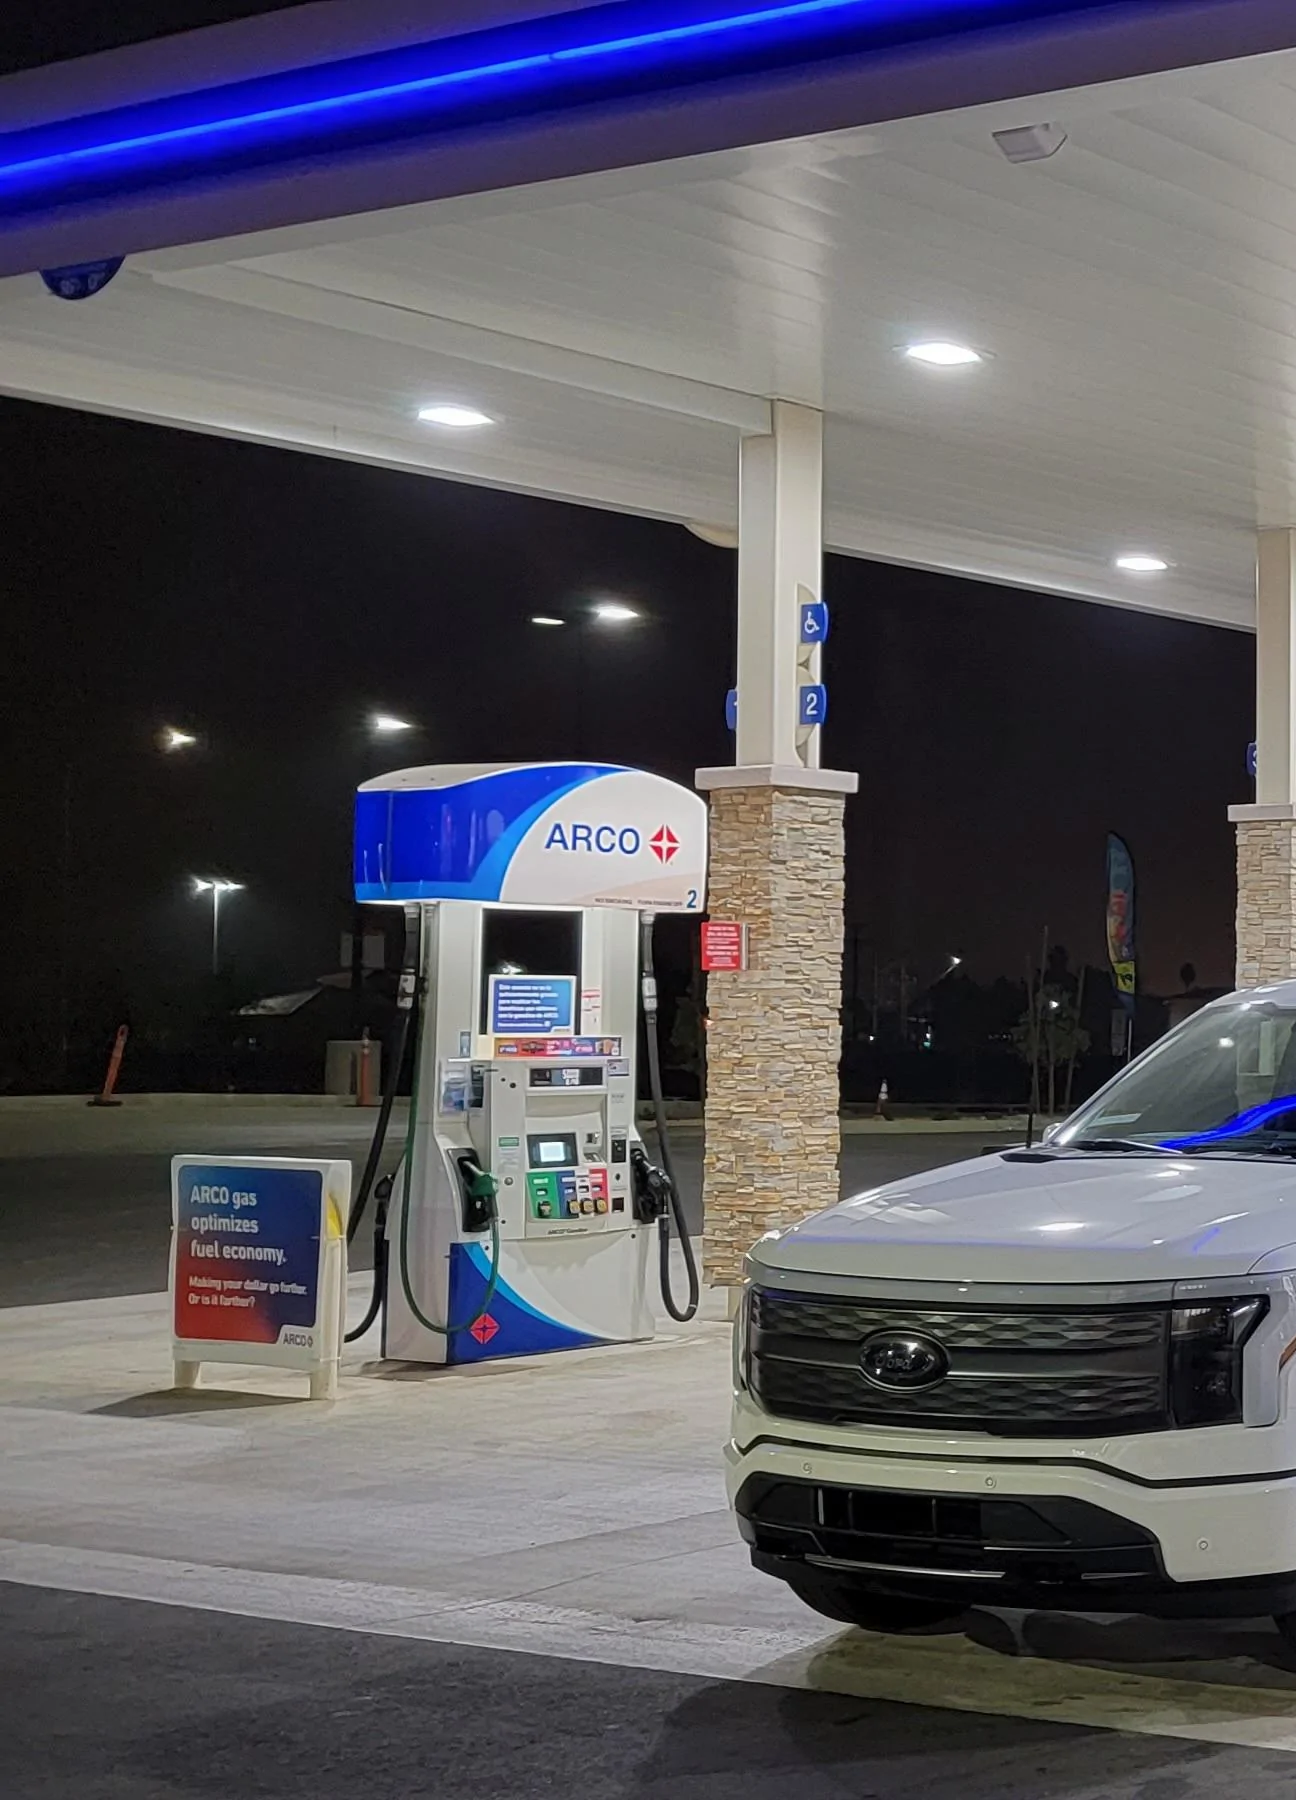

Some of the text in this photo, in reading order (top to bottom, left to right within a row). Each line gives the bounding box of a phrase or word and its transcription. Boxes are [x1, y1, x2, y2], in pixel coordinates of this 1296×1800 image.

[806, 692, 818, 715] 2
[545, 823, 640, 854] ARCO
[686, 890, 697, 909] 2
[190, 1185, 257, 1210] ARCO gas
[191, 1213, 259, 1234] optimizes
[191, 1239, 287, 1266] fuel economy.
[189, 1276, 221, 1291] Making
[223, 1280, 243, 1292] your
[244, 1280, 268, 1291] dollar
[269, 1283, 279, 1294] go
[188, 1292, 200, 1304] Or
[201, 1295, 210, 1305] is
[211, 1295, 218, 1305] it
[283, 1333, 306, 1347] ARCO
